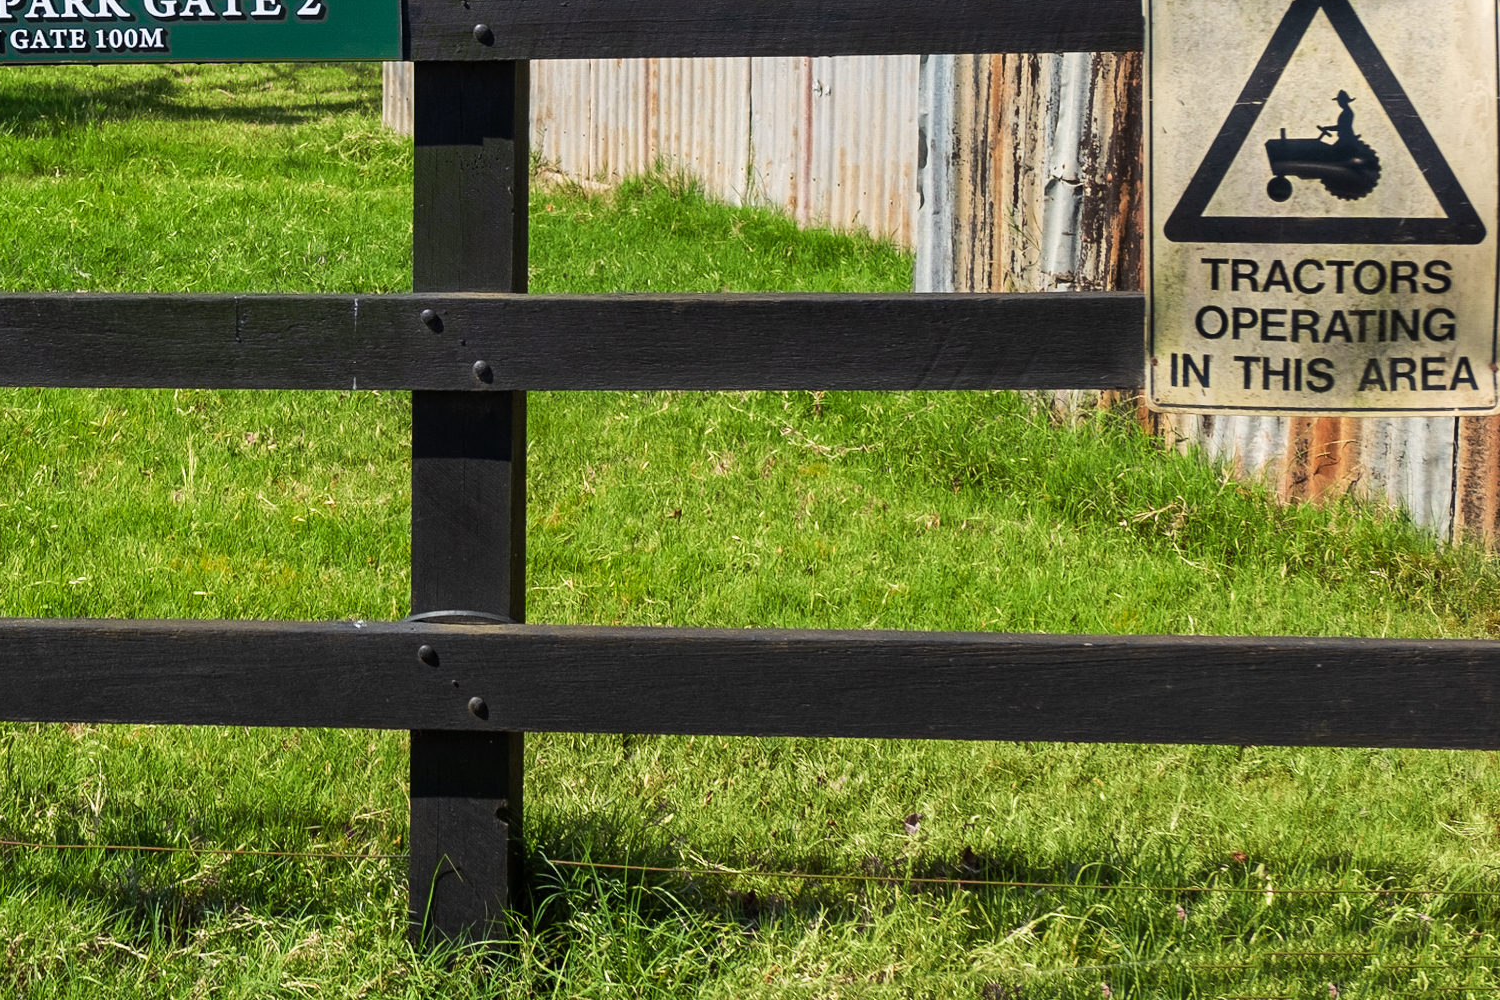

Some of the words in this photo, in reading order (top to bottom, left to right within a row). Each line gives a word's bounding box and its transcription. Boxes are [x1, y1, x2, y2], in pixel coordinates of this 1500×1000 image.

[9, 29, 87, 50] GATE
[94, 28, 165, 50] 100M
[1200, 257, 1453, 295] TRACTORS
[1194, 305, 1457, 343] OPERATING
[1170, 353, 1211, 388] IN
[1234, 356, 1335, 393] THIS
[1358, 357, 1479, 391] AREA
